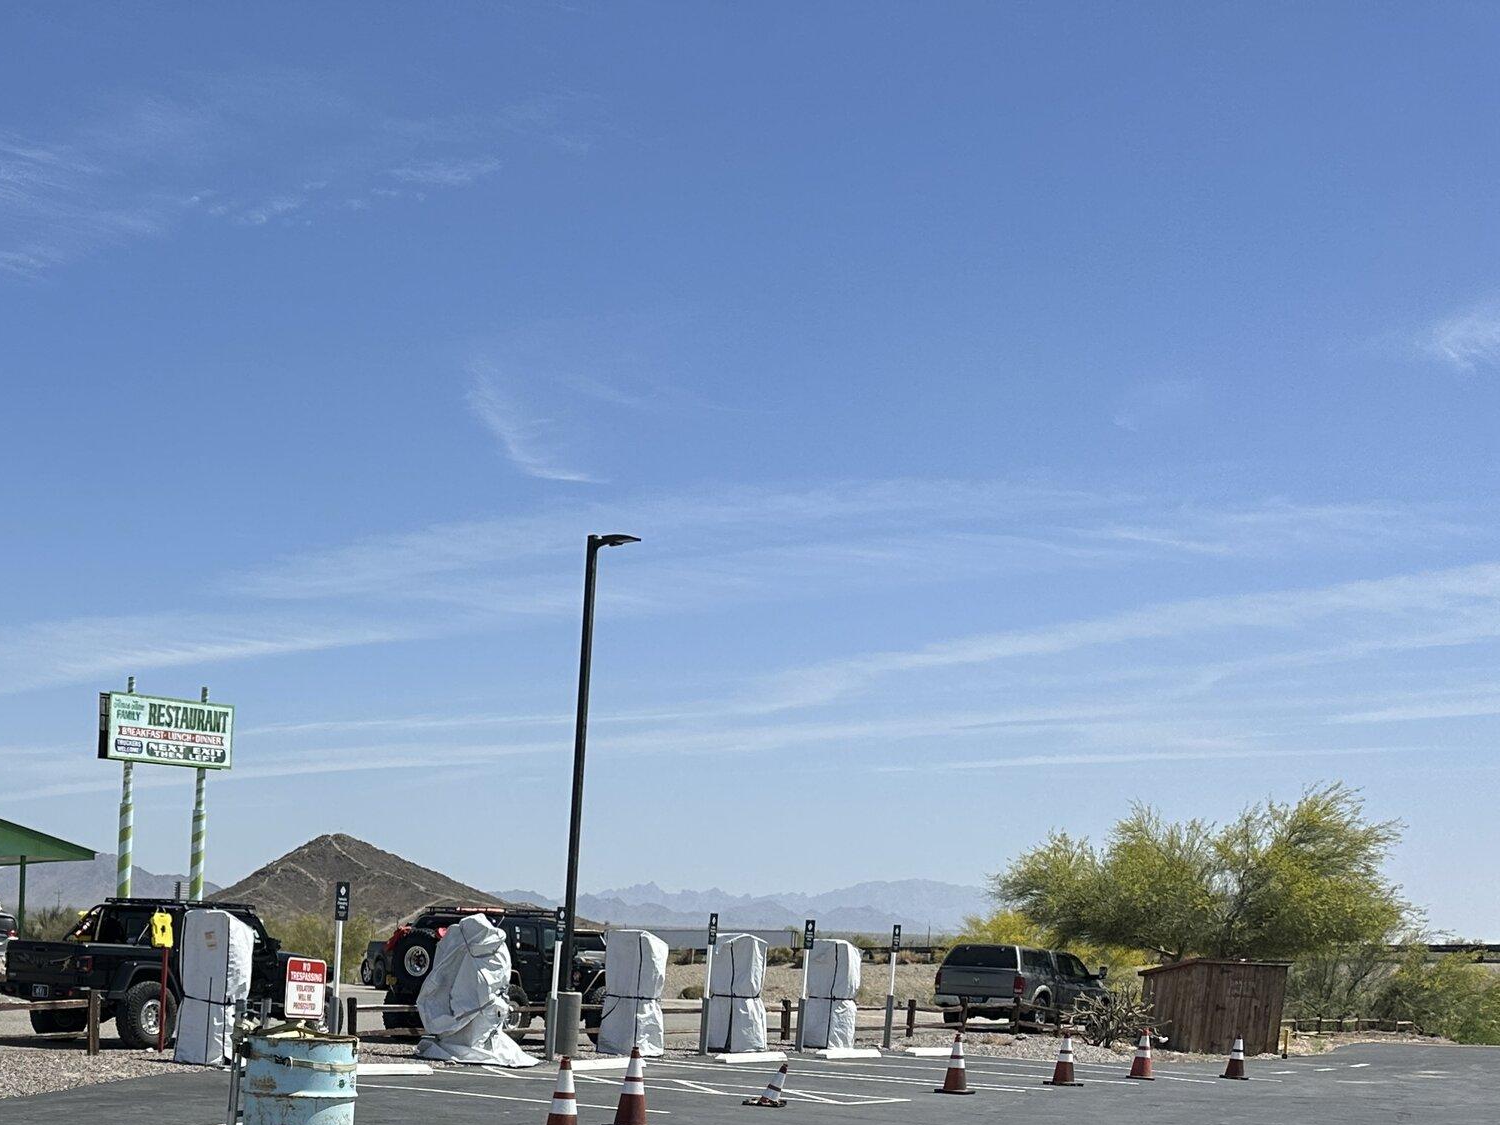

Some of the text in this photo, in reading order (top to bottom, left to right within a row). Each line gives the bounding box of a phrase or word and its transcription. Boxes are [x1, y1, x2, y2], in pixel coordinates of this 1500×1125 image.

[116, 709, 141, 721] FAMILY
[147, 702, 229, 733] RESTAURANT
[121, 727, 222, 745] BREAKFAST LUNCH DINNER
[149, 742, 223, 757] NEXT EXIT
[154, 750, 217, 763] THEN LEFT
[302, 962, 311, 971] NO
[291, 971, 322, 982] TRESPASSING
